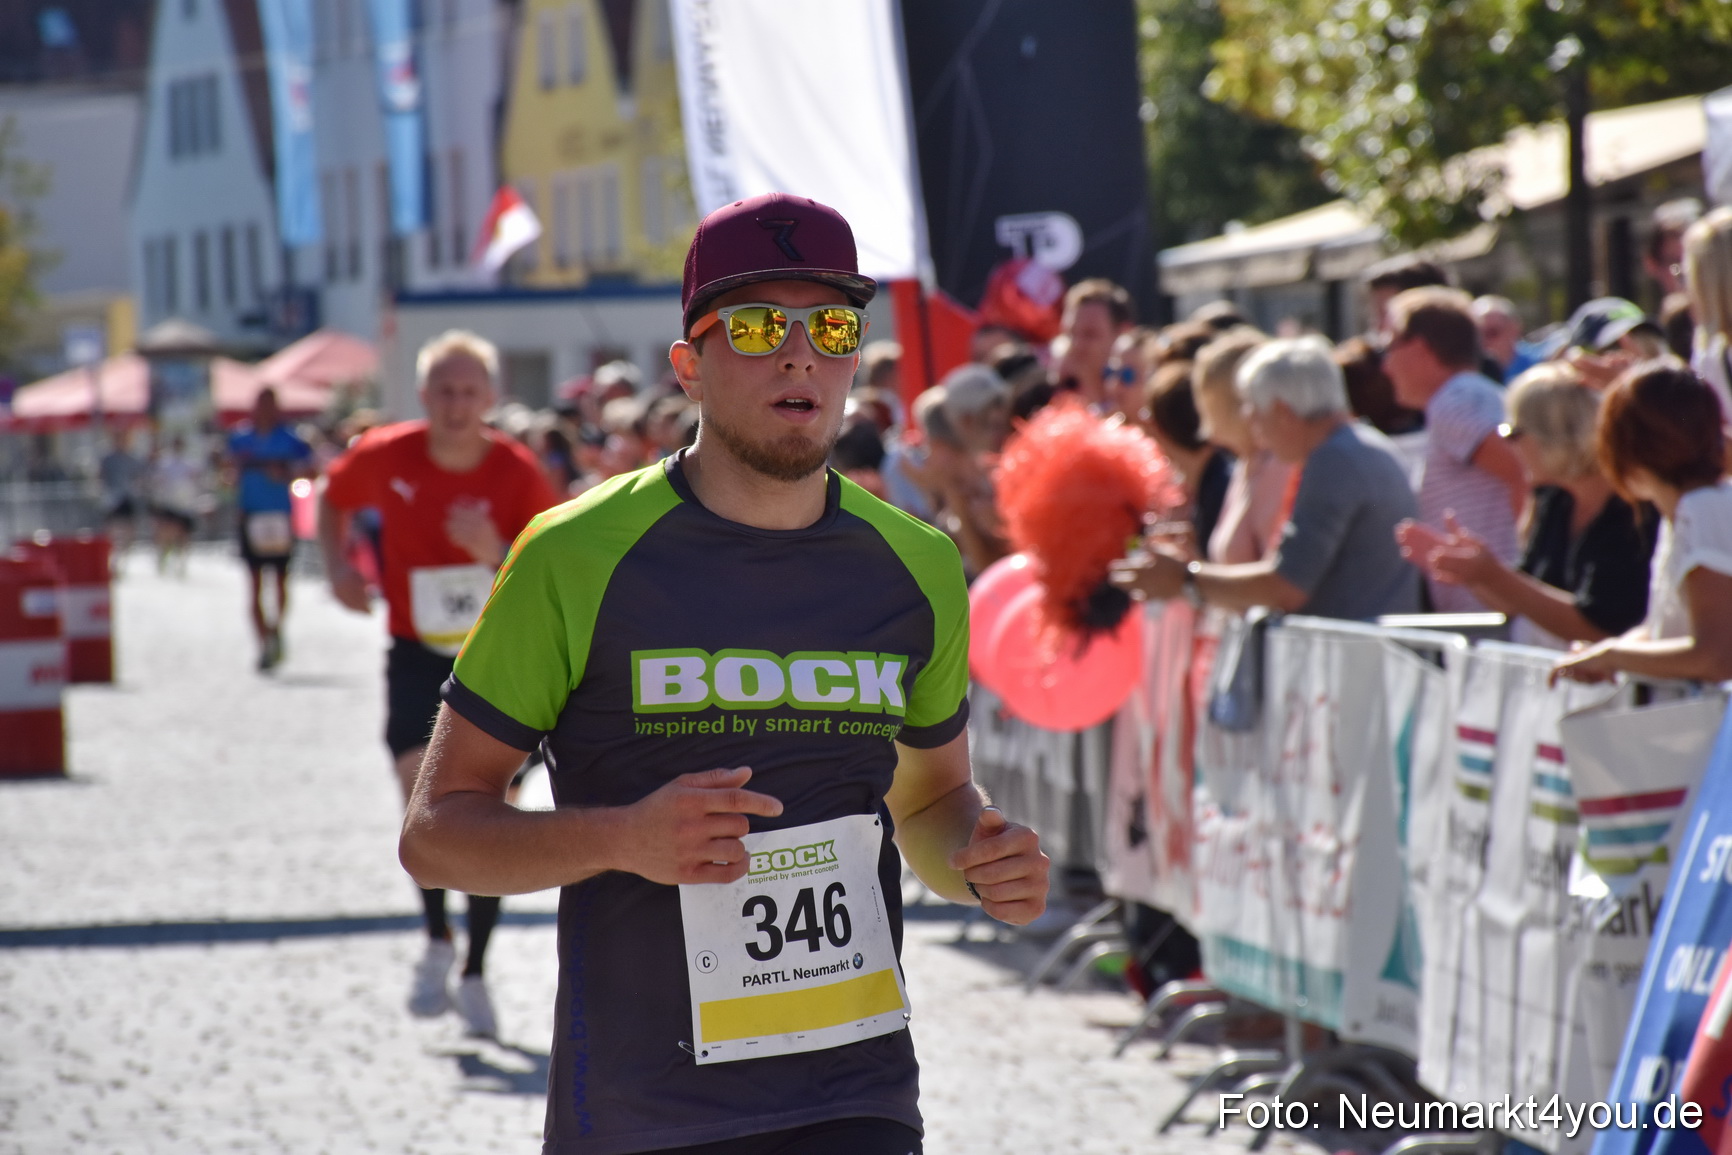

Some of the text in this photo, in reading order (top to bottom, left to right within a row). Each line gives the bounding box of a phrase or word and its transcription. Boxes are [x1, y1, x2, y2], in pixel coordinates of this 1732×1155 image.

[639, 656, 904, 708] BOCK
[634, 714, 726, 739] inspired
[732, 714, 758, 737] by
[765, 718, 832, 734] smart
[749, 840, 838, 875] BOCK
[747, 863, 840, 885] inspired by smart concepts
[741, 881, 852, 962] 346
[702, 956, 711, 969] C
[742, 959, 850, 988] PARTL Neumarkt
